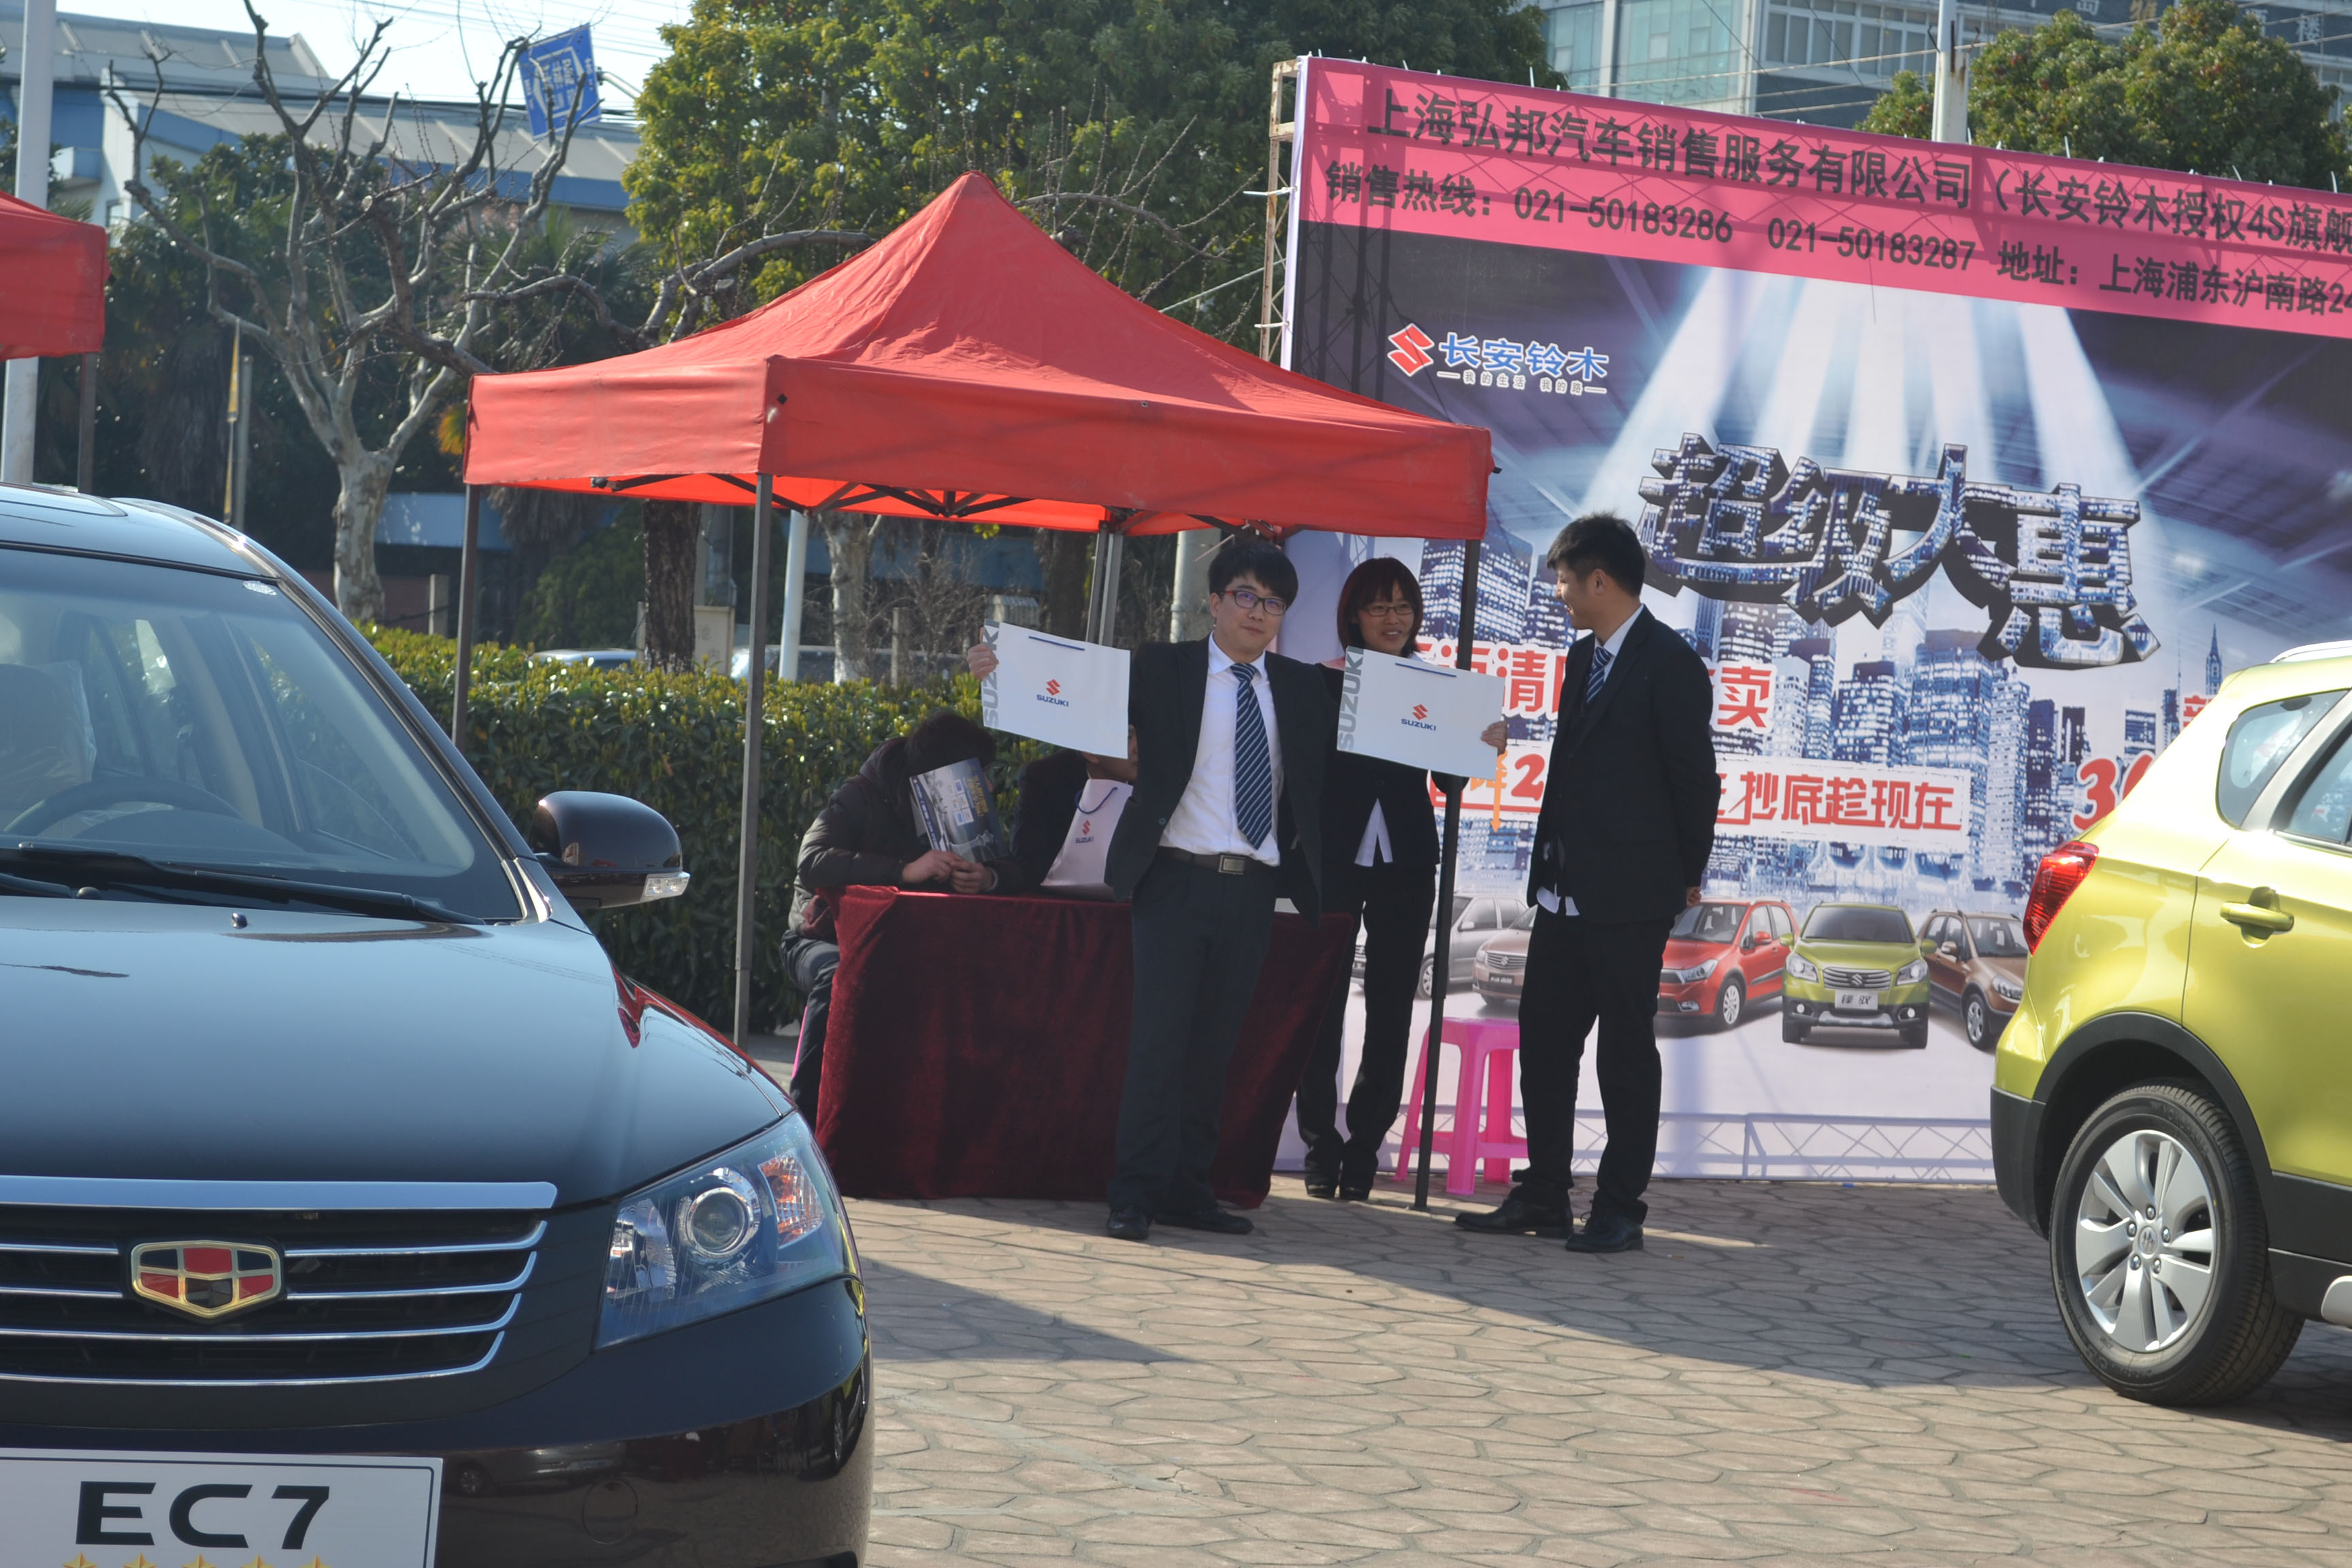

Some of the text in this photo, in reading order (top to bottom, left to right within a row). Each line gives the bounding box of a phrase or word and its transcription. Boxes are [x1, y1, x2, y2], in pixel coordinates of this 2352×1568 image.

[1514, 187, 1733, 243] 021-50183286
[1767, 218, 1975, 271] 021-50183287
[1439, 332, 1609, 380] 长安铃木
[1635, 432, 2160, 670] 超级大惠
[983, 619, 1000, 728] SUZKI
[1036, 694, 1069, 707] SUZUKI
[1337, 645, 1364, 751] SUZUKI
[1401, 718, 1437, 731] SUZUKI
[1075, 836, 1094, 845] SUZUKI
[76, 1480, 330, 1550] EC7
